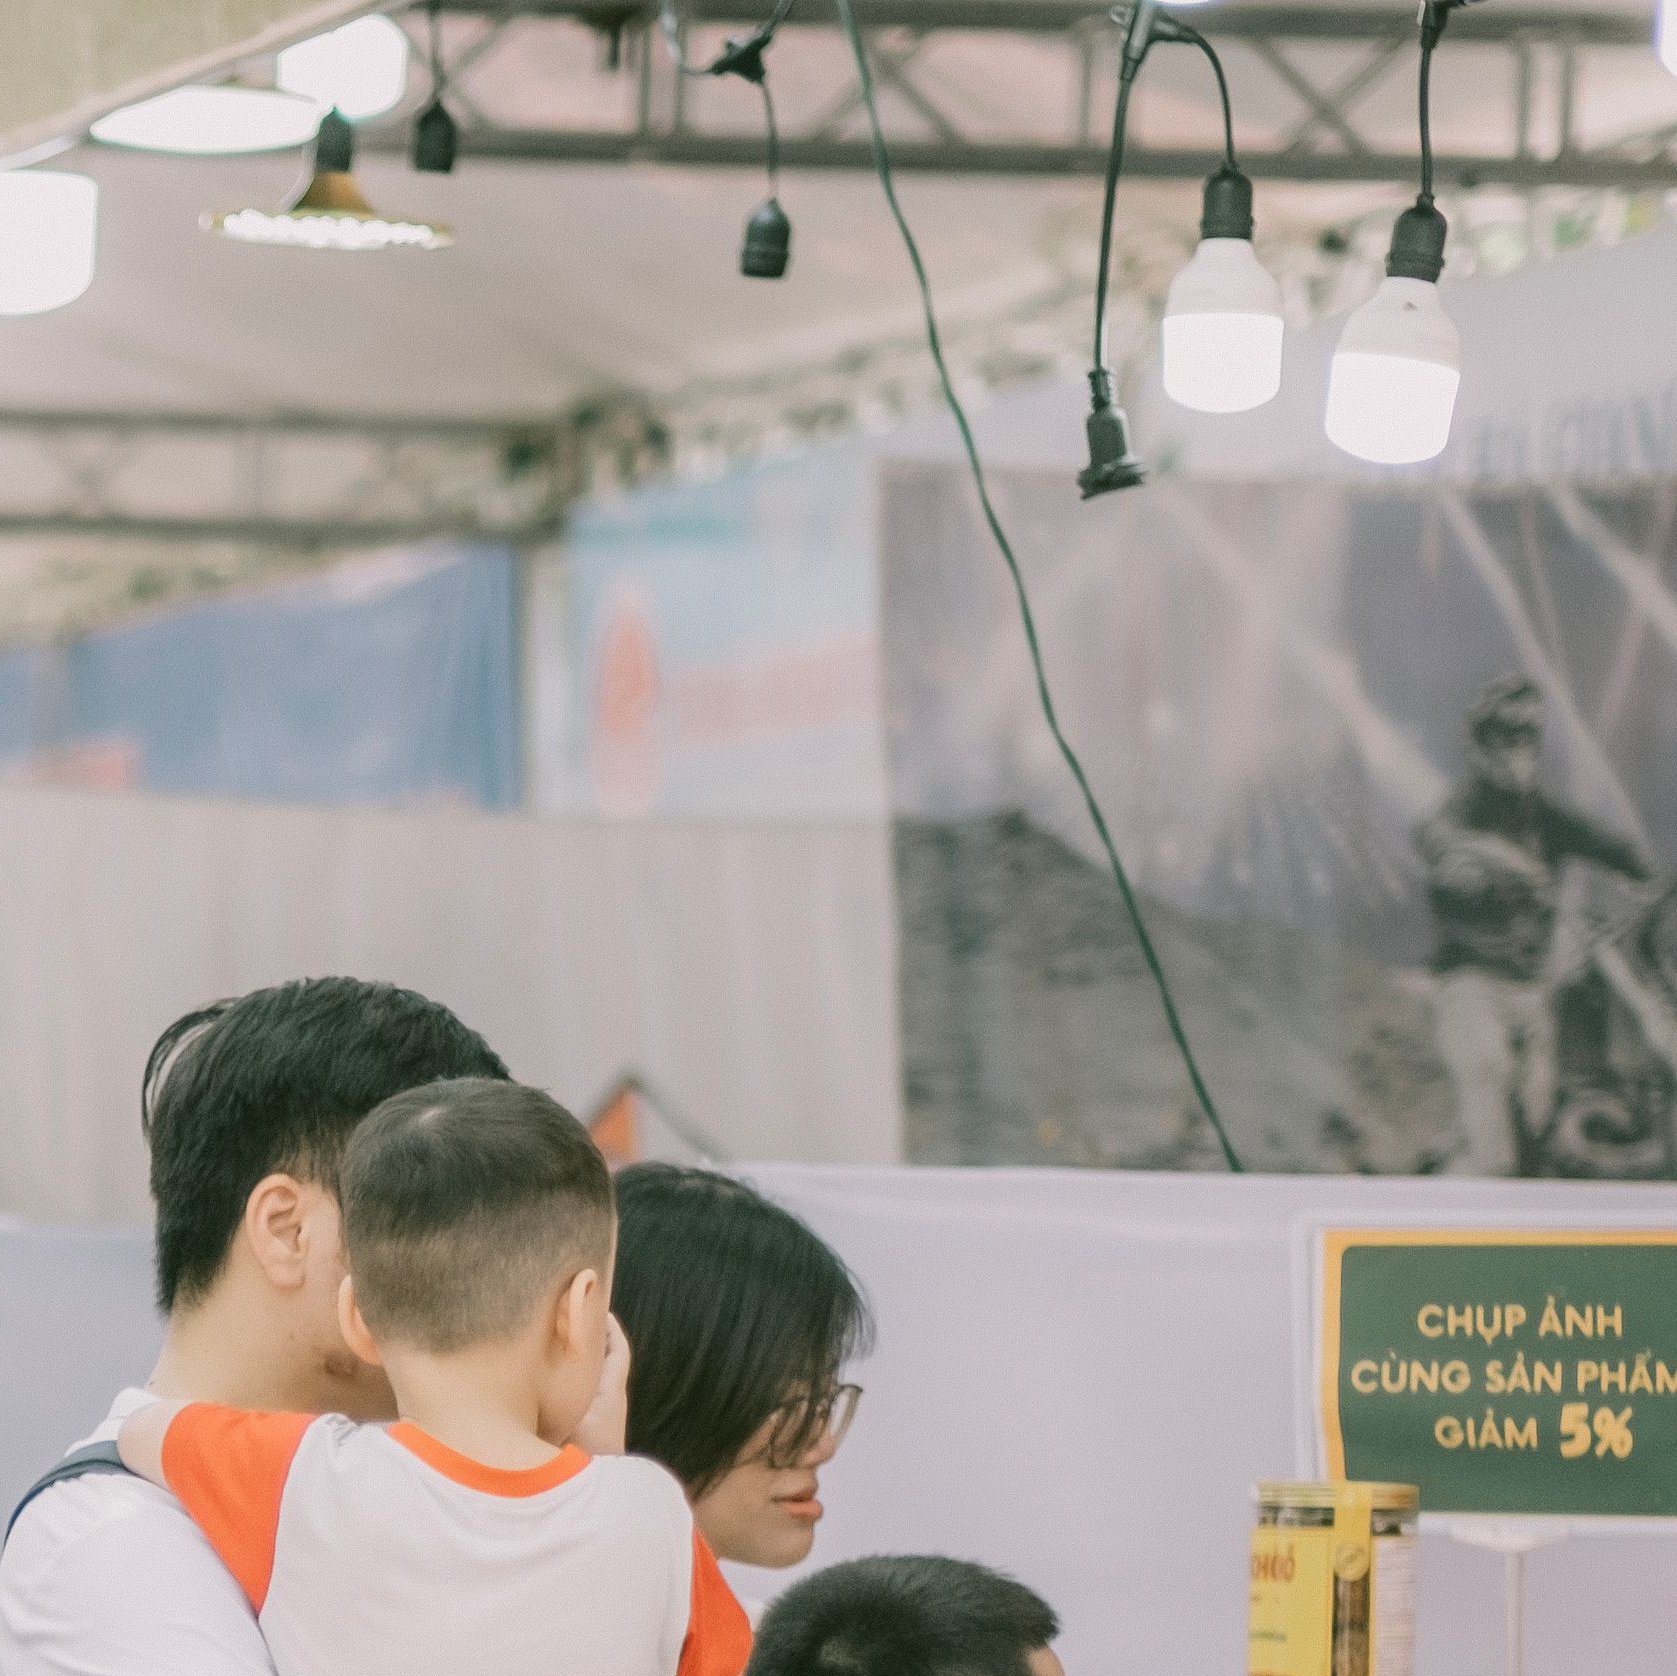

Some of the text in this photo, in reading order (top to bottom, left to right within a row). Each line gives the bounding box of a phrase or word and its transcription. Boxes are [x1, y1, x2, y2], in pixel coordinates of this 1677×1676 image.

[1416, 1293, 1623, 1346] CHỤP ẢNH
[1350, 1352, 1472, 1394] CÙNG
[1485, 1350, 1563, 1394] SẢN
[1433, 1401, 1634, 1459] GIẢM 5%
